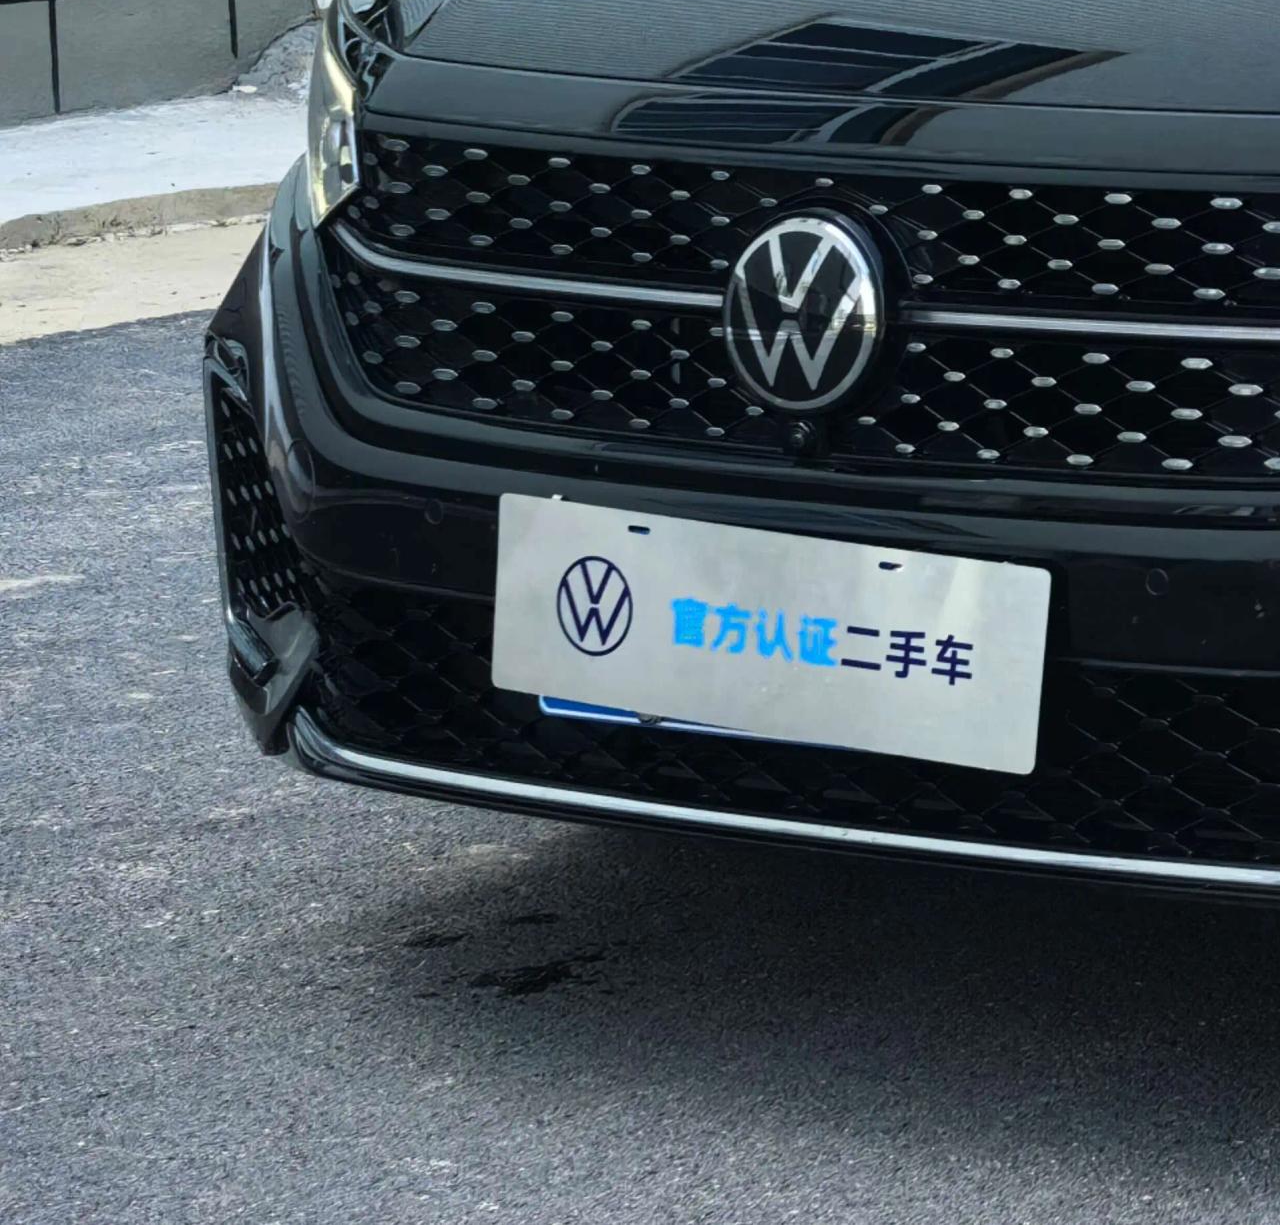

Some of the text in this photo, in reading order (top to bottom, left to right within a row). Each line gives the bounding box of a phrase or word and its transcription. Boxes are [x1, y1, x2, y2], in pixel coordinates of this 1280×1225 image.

[671, 598, 974, 685] 官方认证二手车
